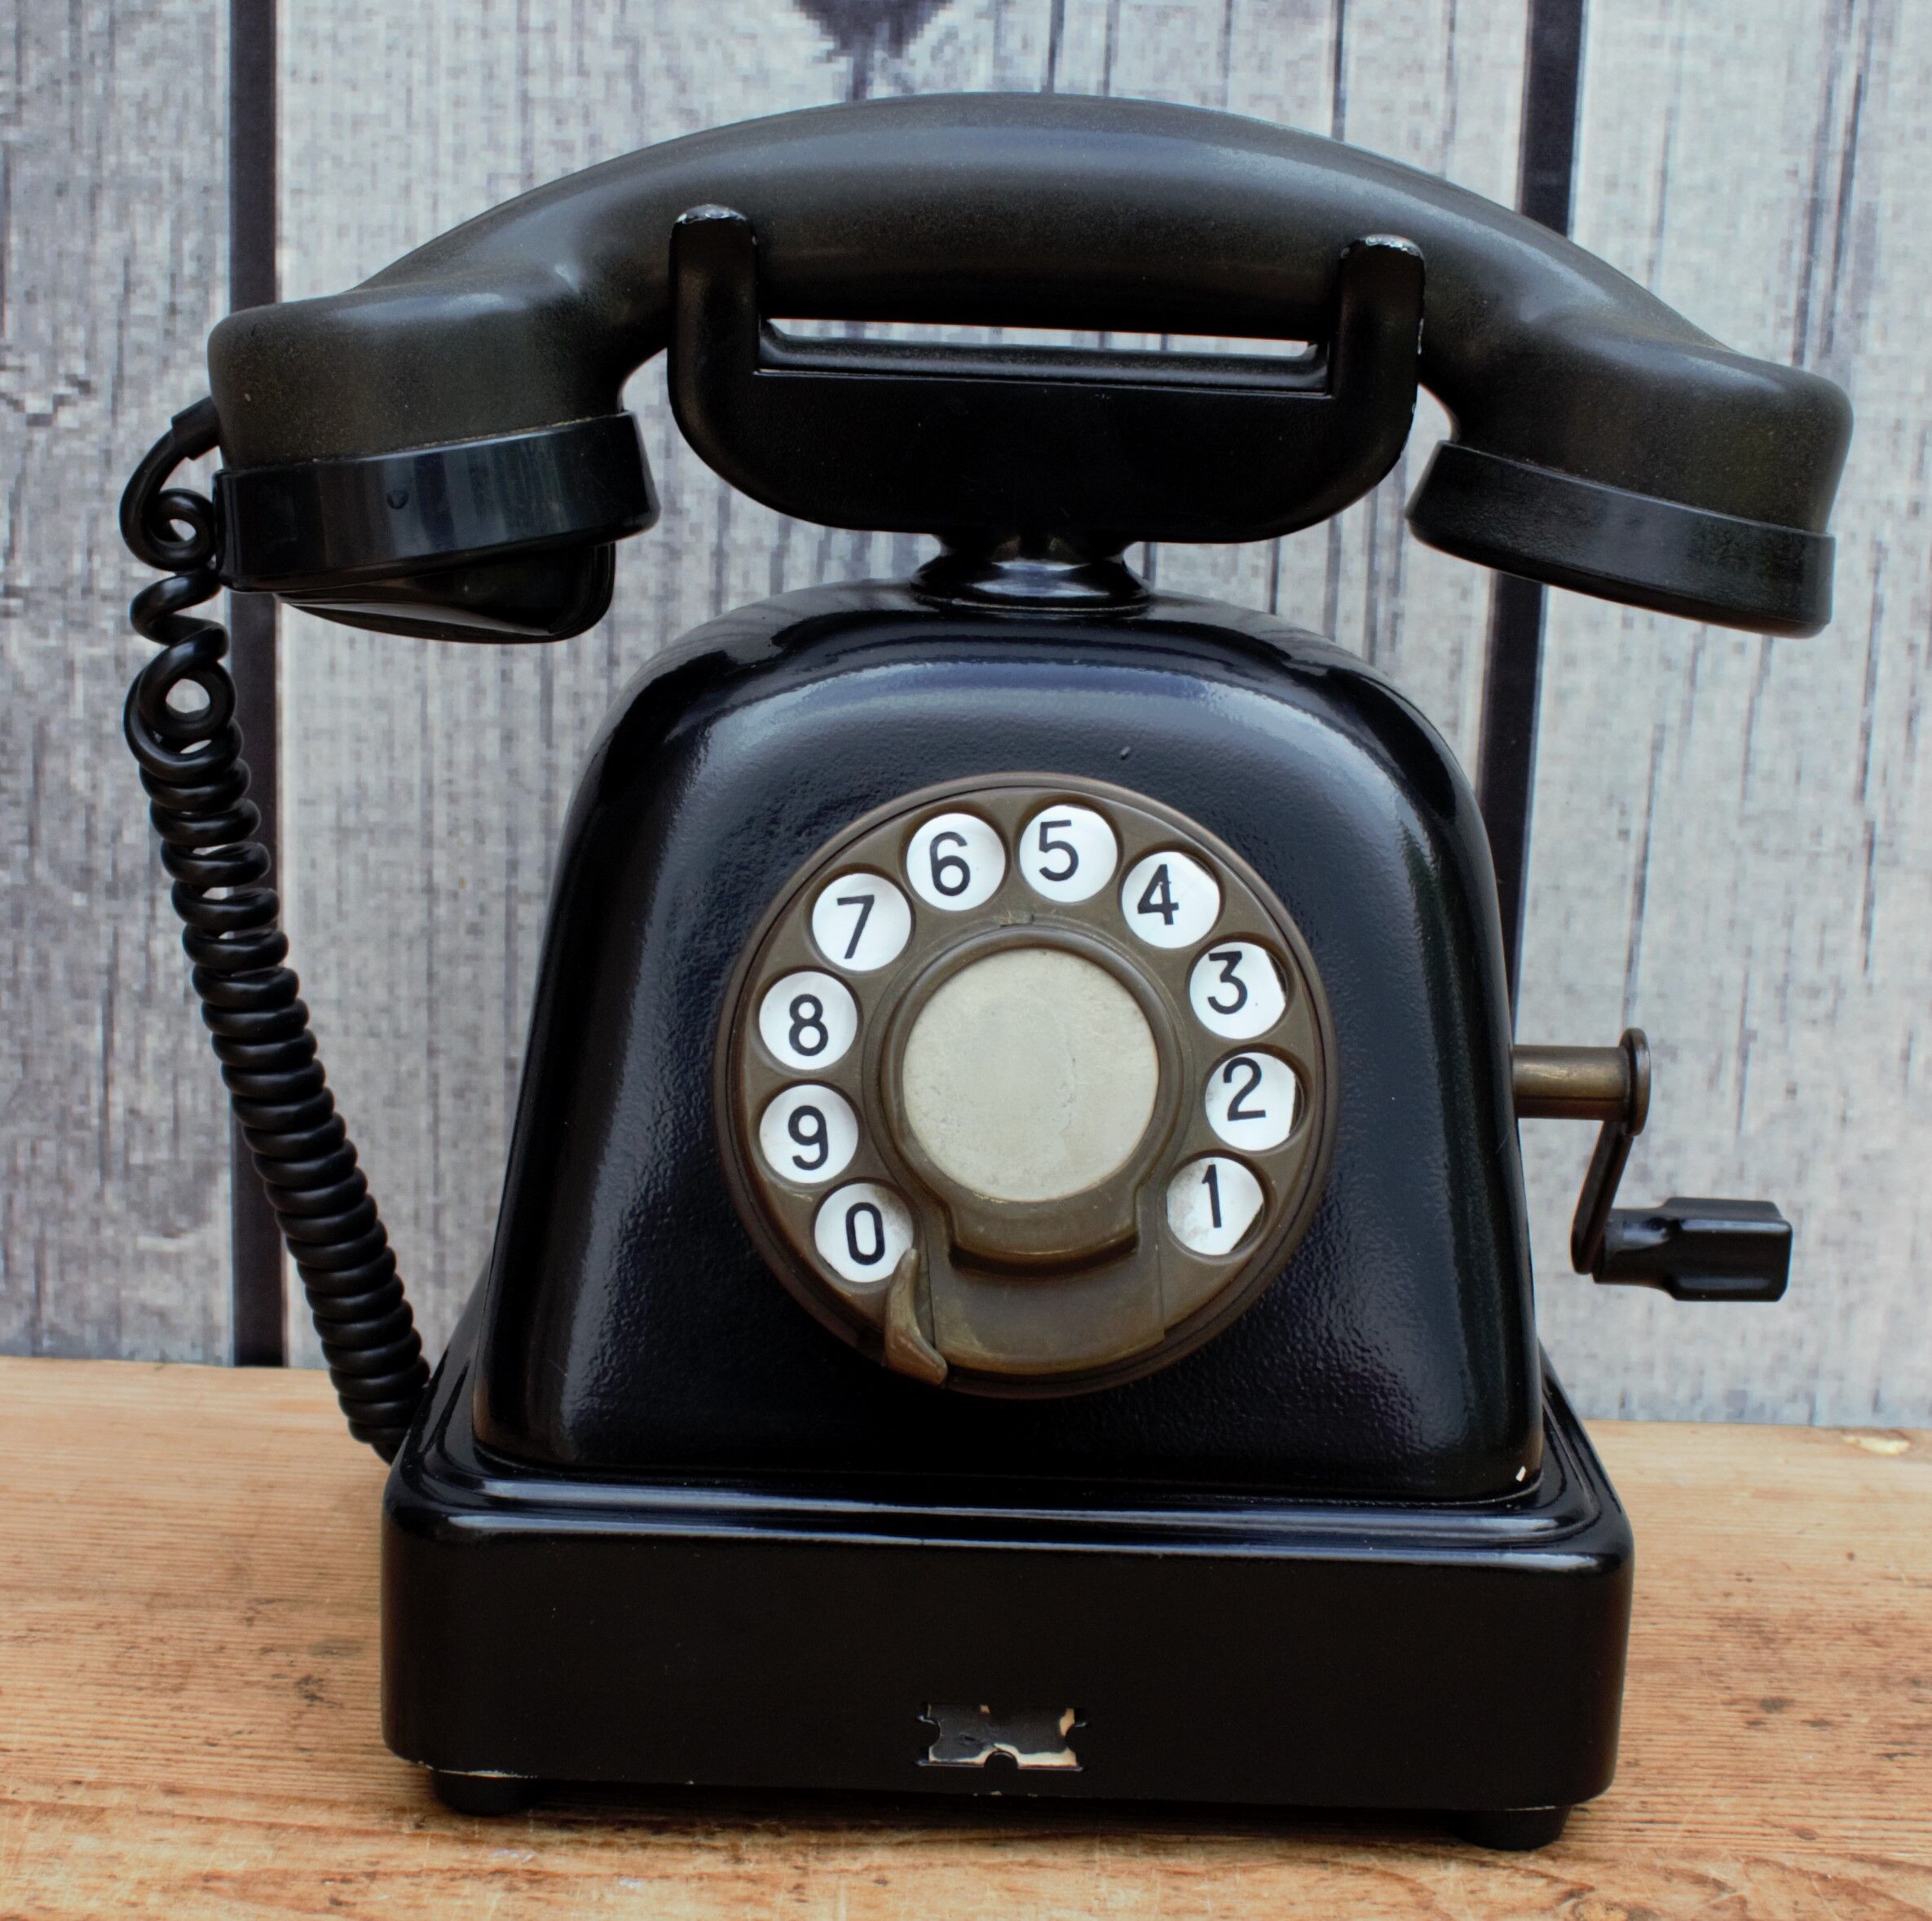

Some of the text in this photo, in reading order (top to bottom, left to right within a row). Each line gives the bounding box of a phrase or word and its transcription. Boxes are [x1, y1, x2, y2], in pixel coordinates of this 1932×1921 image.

[930, 832, 970, 896] 6
[1039, 820, 1078, 881] 5
[1138, 864, 1178, 925] 4
[837, 895, 874, 959] 7
[1207, 951, 1248, 1014] 3
[789, 995, 828, 1056] 8
[1223, 1057, 1266, 1121] 2
[788, 1106, 828, 1170] 9
[1201, 1164, 1223, 1229] 1
[846, 1202, 884, 1265] 0
